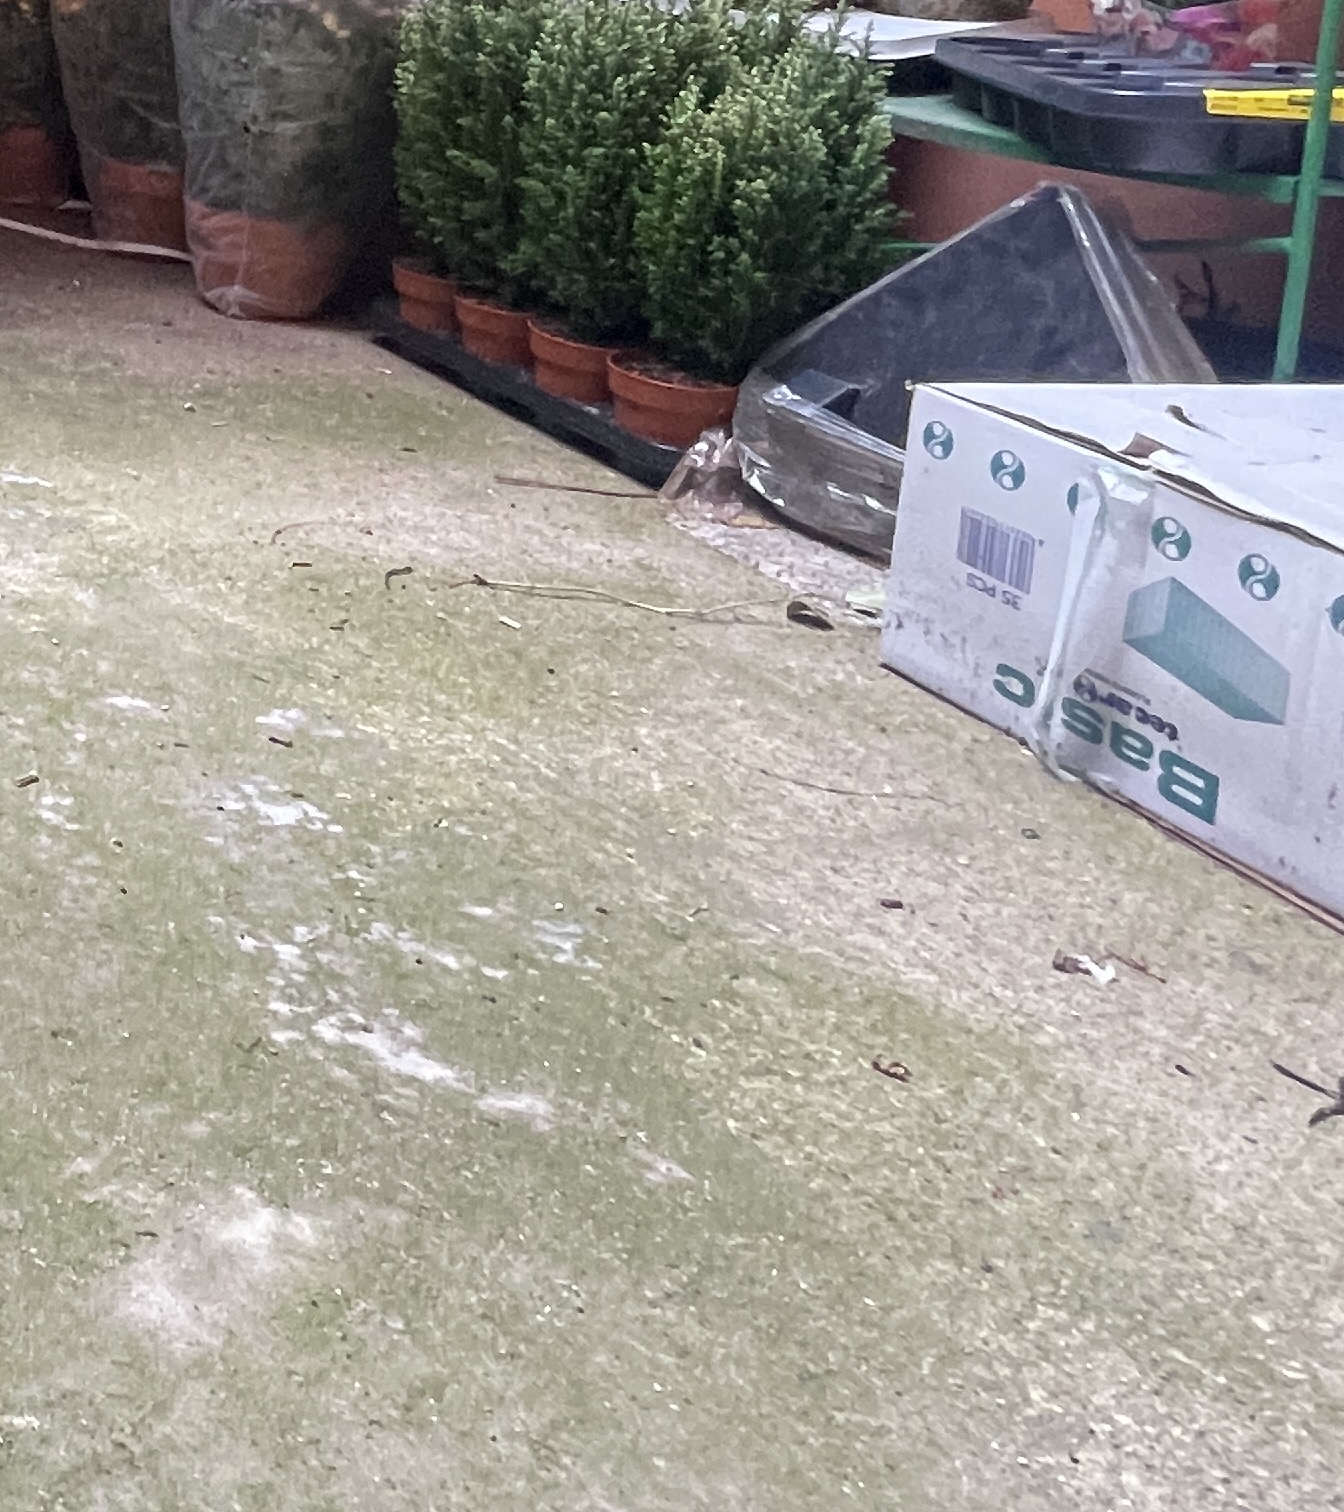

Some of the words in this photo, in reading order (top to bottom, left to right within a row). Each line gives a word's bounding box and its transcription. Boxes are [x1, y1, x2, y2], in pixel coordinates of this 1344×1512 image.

[966, 572, 996, 598] PCS
[1000, 590, 1023, 611] 35
[992, 662, 1221, 827] Basc
